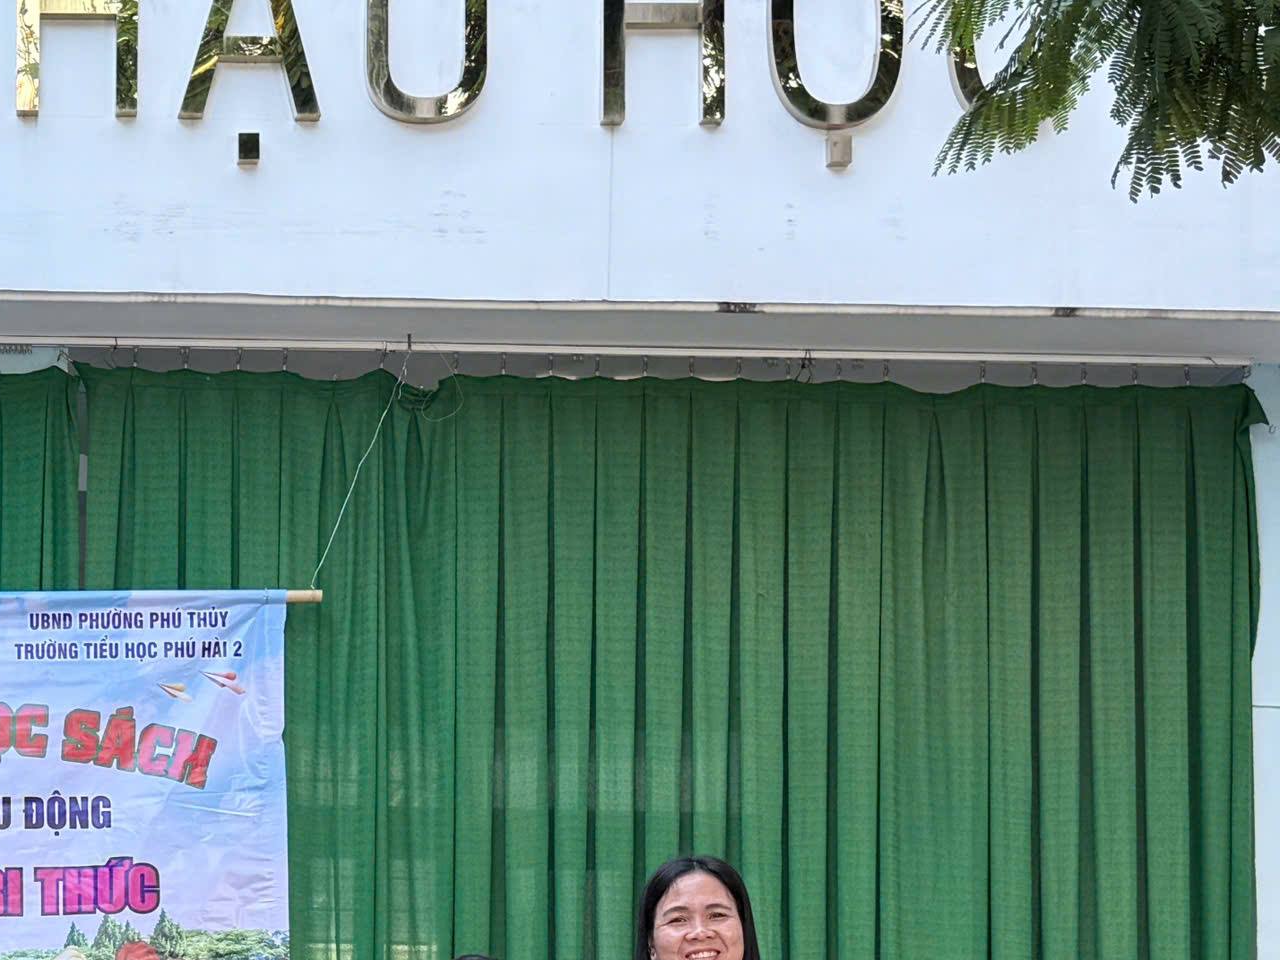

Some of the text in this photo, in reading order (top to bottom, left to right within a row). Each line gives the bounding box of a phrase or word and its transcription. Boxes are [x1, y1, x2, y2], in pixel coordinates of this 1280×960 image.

[29, 606, 228, 630] UBND PHƯỜNG PHÚ THỦY
[15, 635, 242, 662] TRƯỜNG TIỂU HỌC PHÚ HÀI 2
[61, 705, 218, 790] SÁCH
[23, 790, 112, 836] ĐỘNG
[34, 856, 160, 917] THỨC
